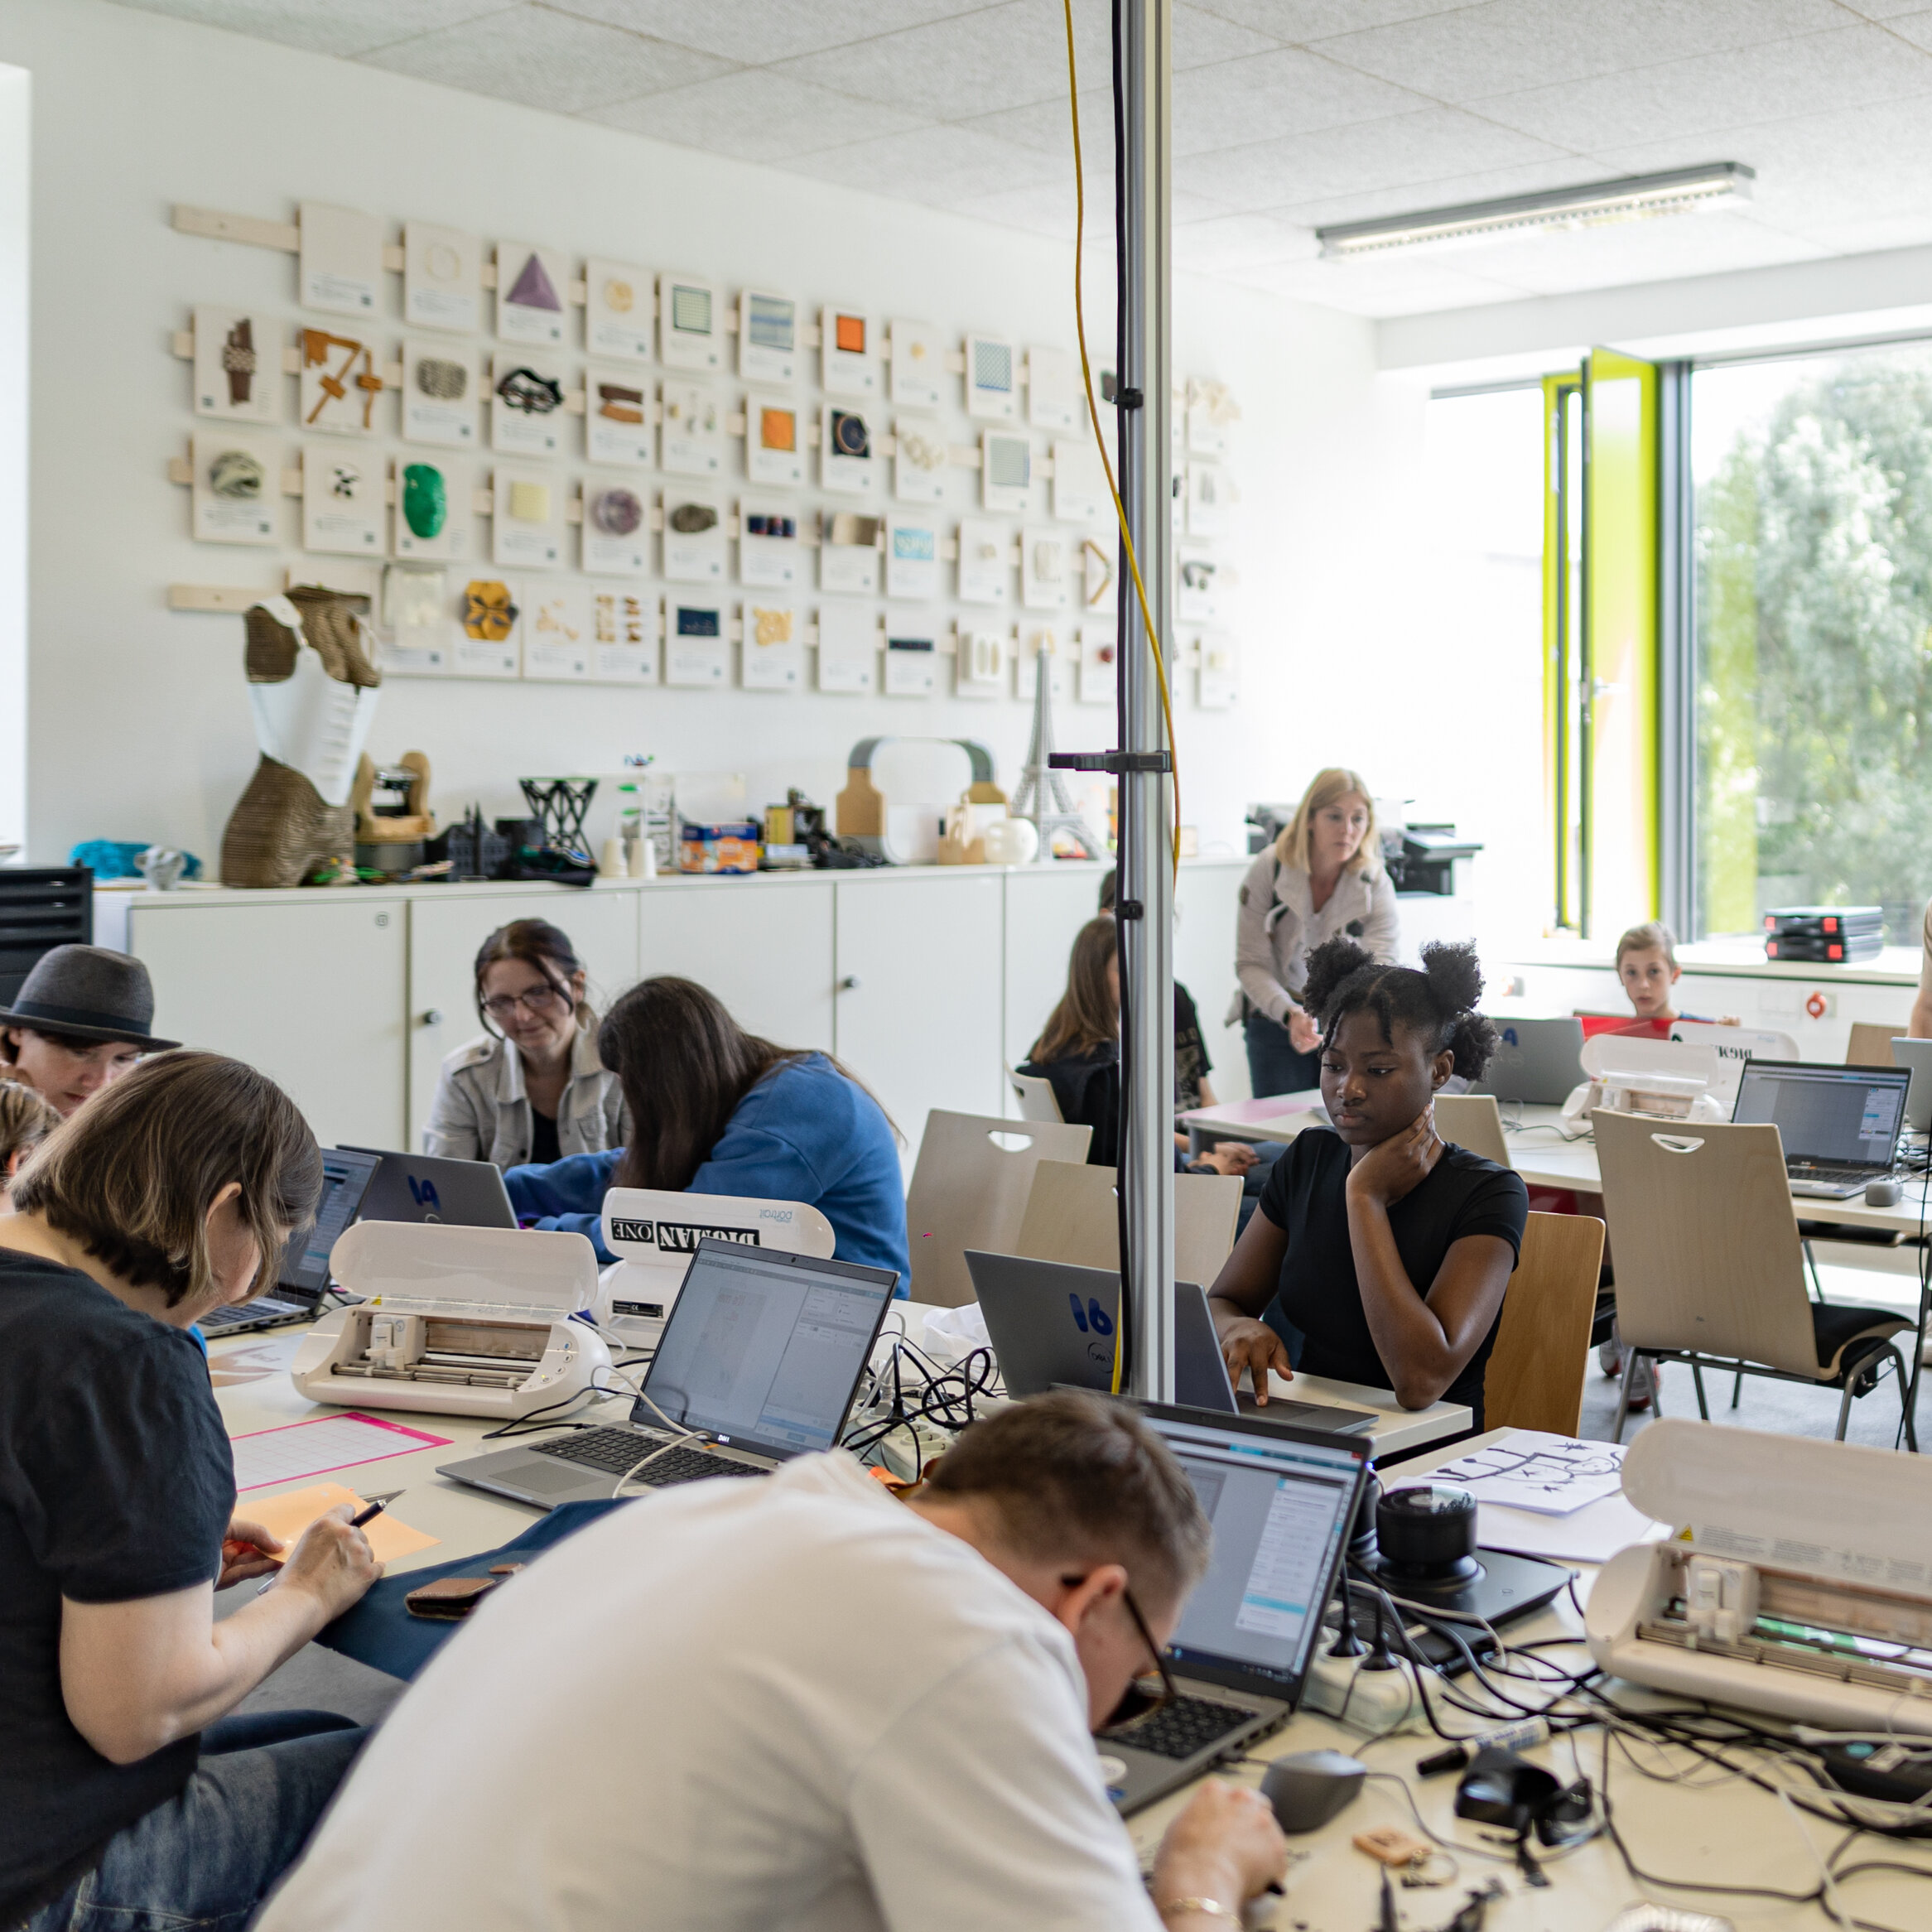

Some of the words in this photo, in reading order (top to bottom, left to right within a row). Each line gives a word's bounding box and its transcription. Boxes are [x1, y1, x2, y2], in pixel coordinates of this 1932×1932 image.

[1711, 1044, 1753, 1060] DIGM
[407, 1175, 441, 1212] 19
[759, 1208, 793, 1220] portrait
[614, 1223, 653, 1241] ONE
[1068, 1293, 1113, 1336] 16
